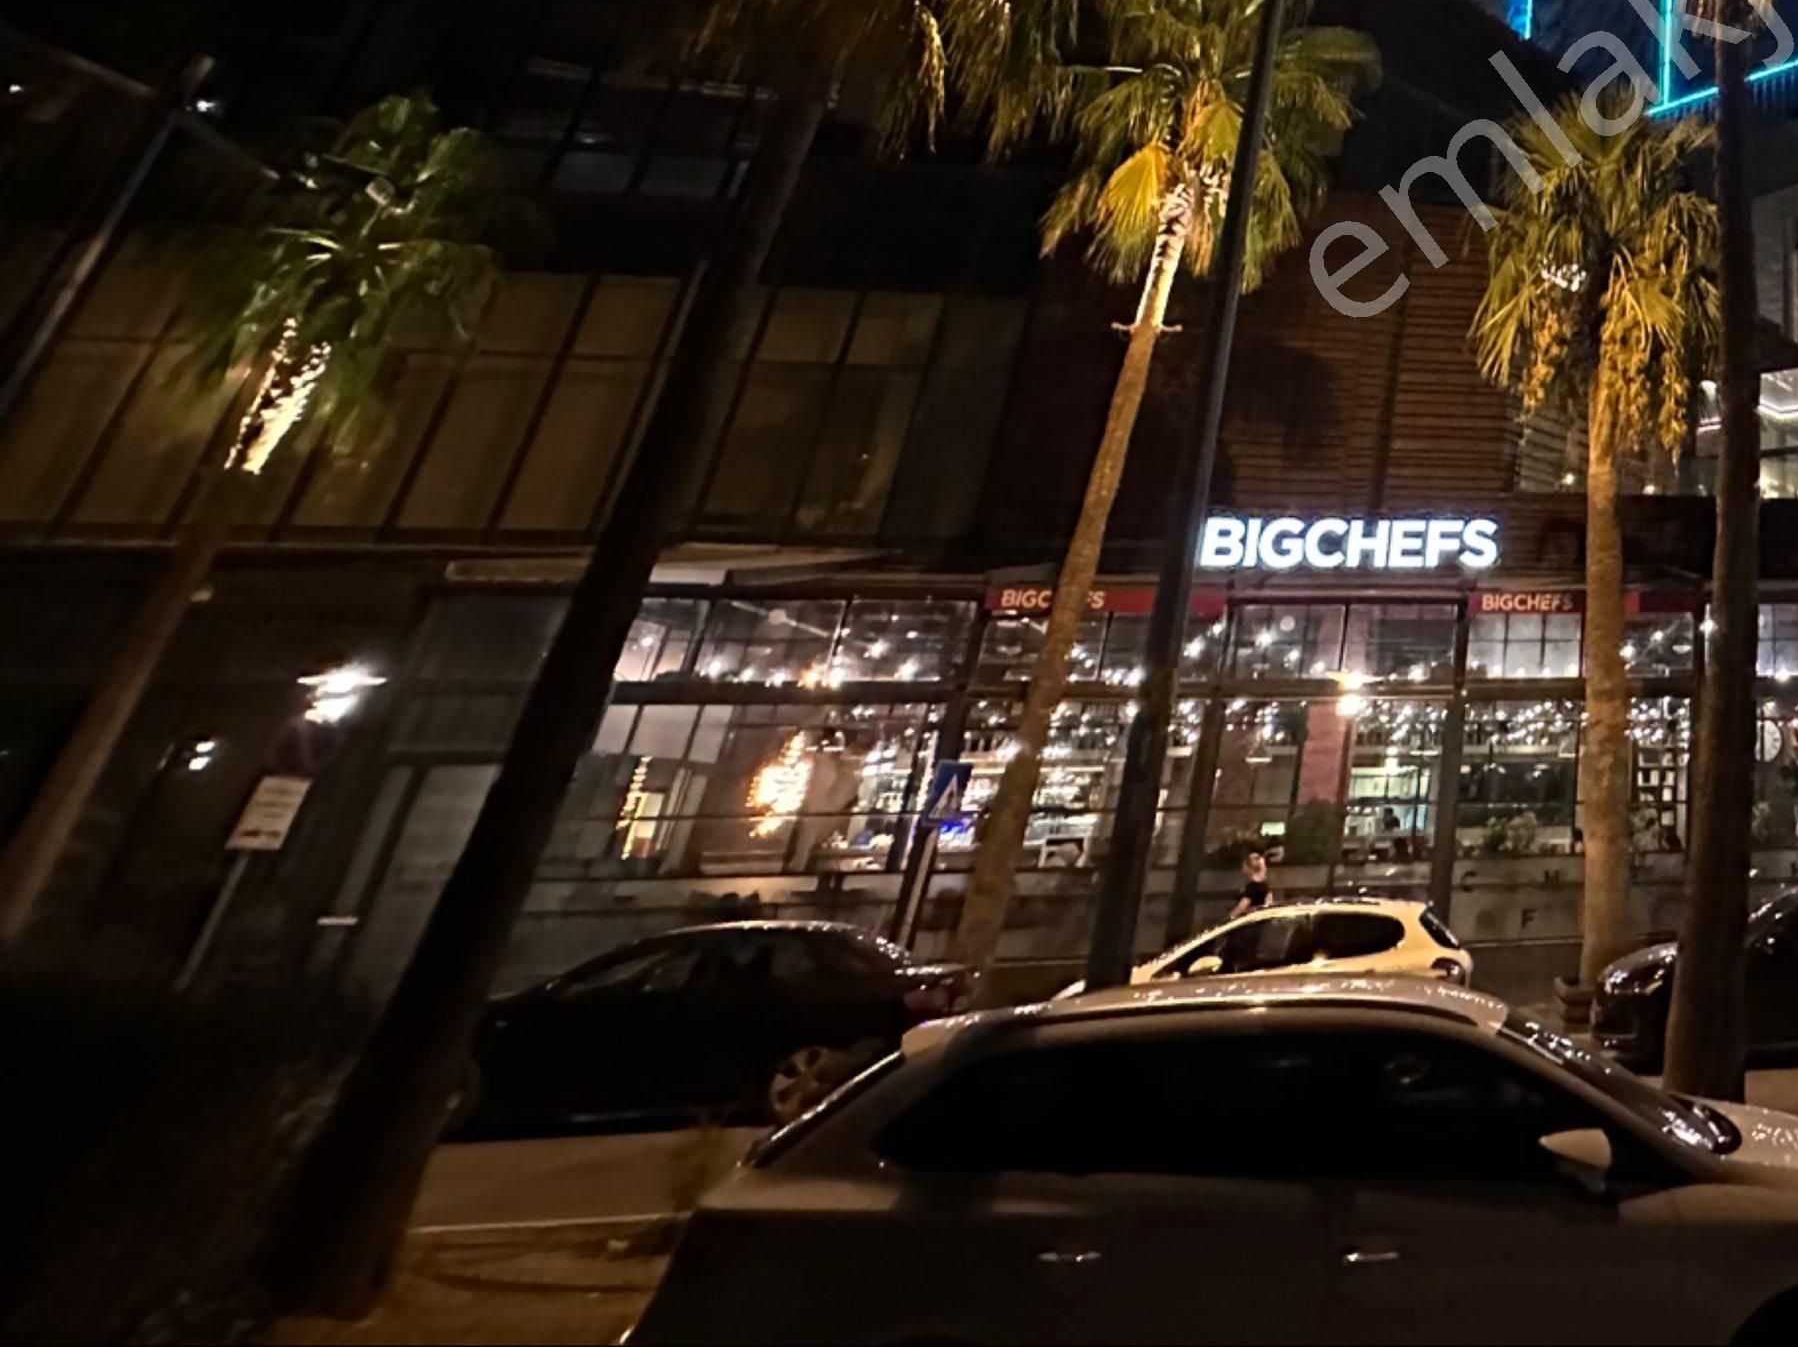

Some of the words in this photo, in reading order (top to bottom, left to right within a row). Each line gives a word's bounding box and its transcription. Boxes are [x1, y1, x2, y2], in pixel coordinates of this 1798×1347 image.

[1199, 515, 1499, 570] BIGCHEFS
[1000, 588, 1106, 609] BIGCS
[1481, 592, 1574, 612] BIGCHEFS
